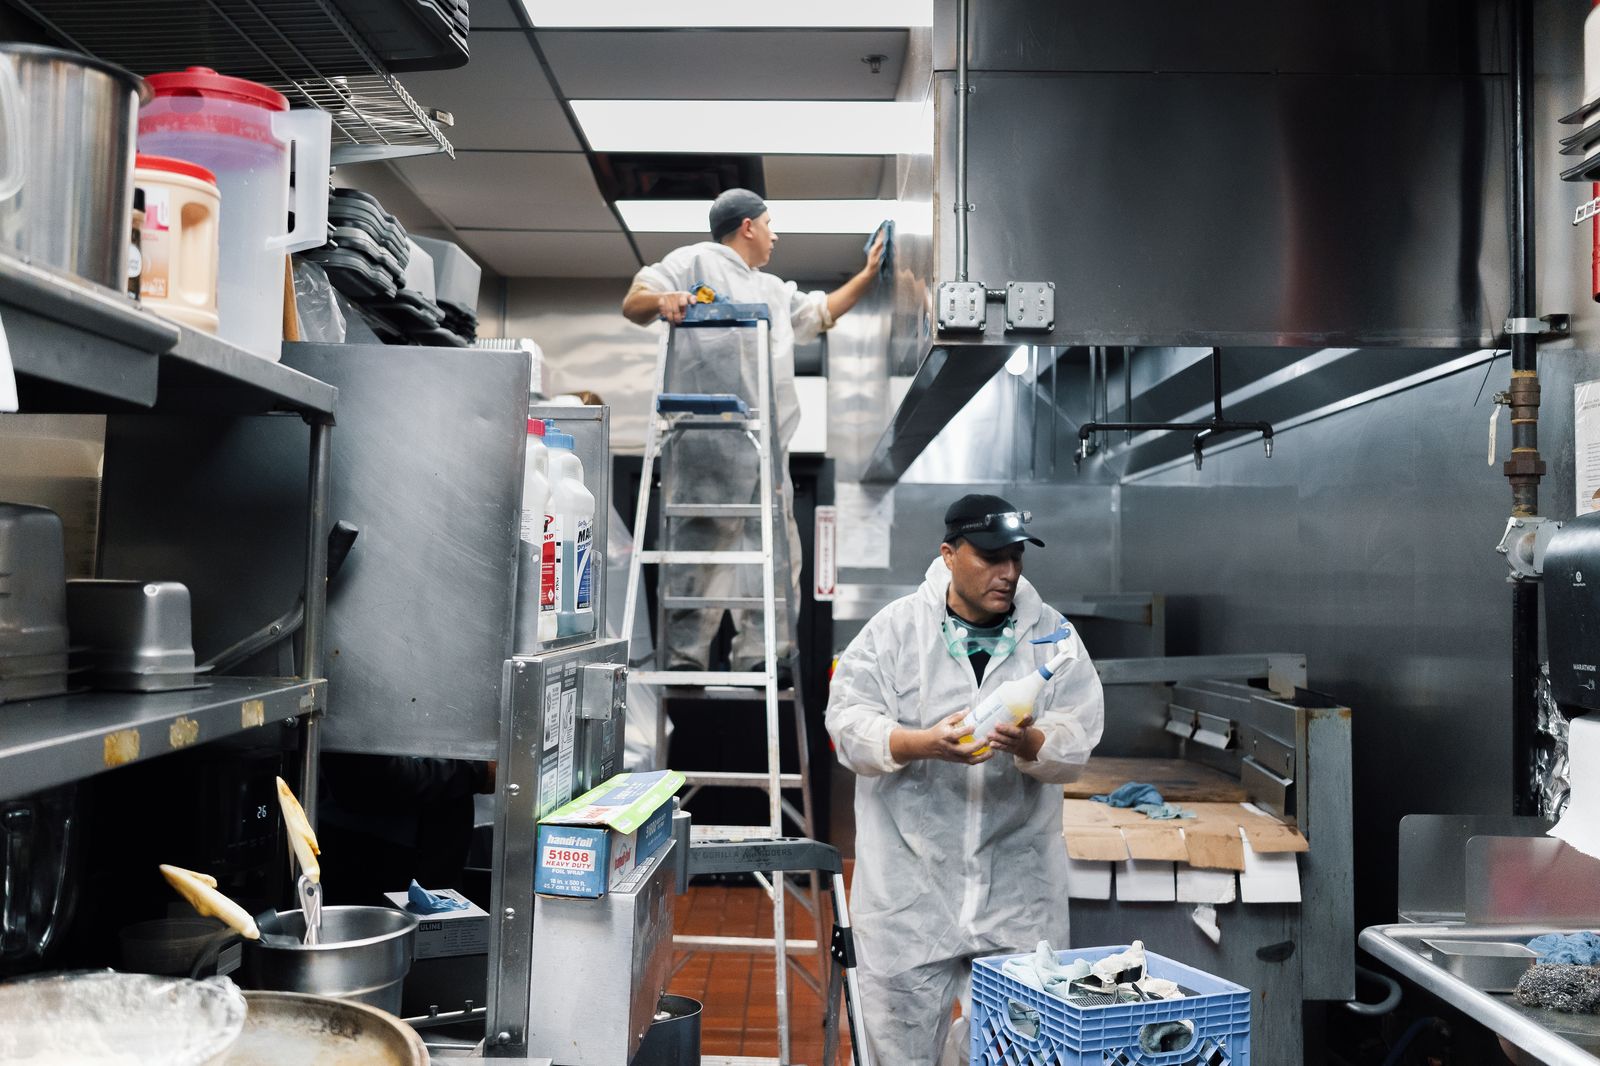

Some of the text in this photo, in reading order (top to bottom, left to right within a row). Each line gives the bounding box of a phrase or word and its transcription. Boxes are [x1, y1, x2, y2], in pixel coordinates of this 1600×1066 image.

[257, 805, 267, 819] 26
[549, 849, 589, 862] 51808
[420, 922, 442, 931] ULINE
